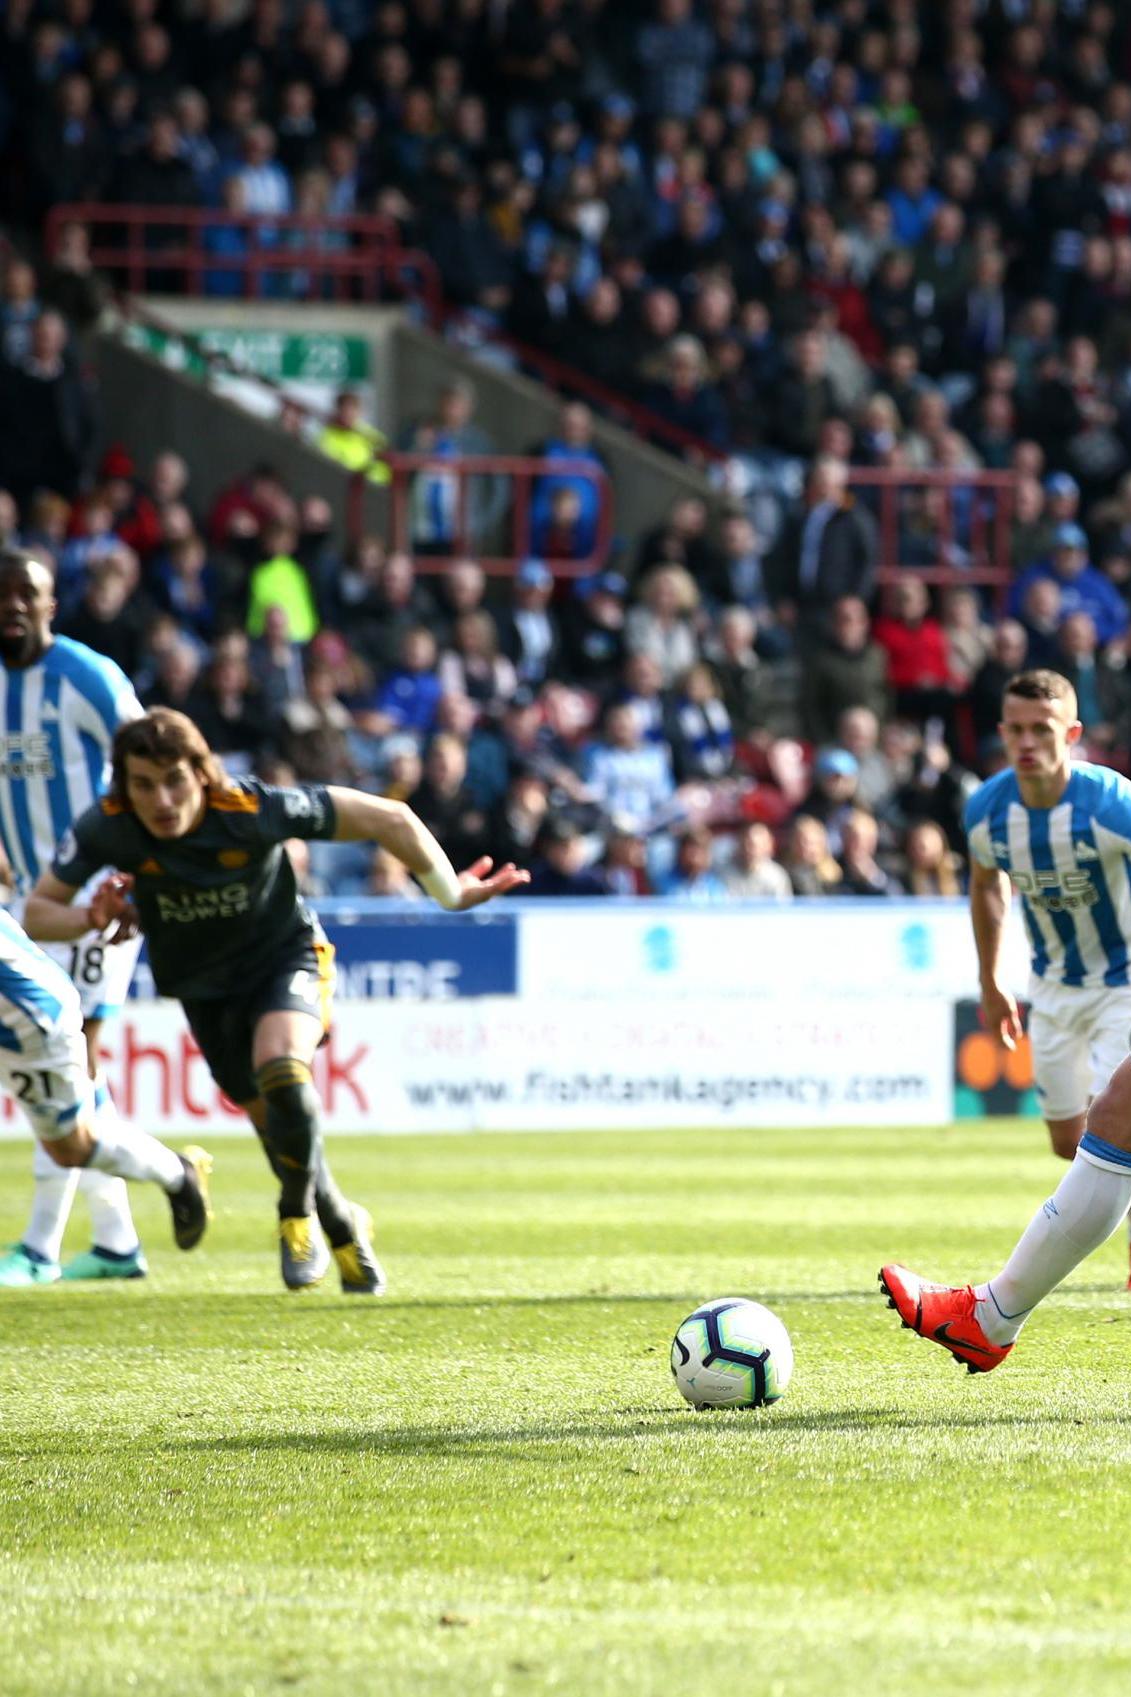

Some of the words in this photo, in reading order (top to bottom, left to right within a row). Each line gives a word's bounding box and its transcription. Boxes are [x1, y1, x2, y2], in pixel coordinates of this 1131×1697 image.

[157, 882, 249, 909] KING
[160, 902, 249, 922] POWER
[69, 945, 104, 985] 18
[10, 1069, 53, 1106] 21
